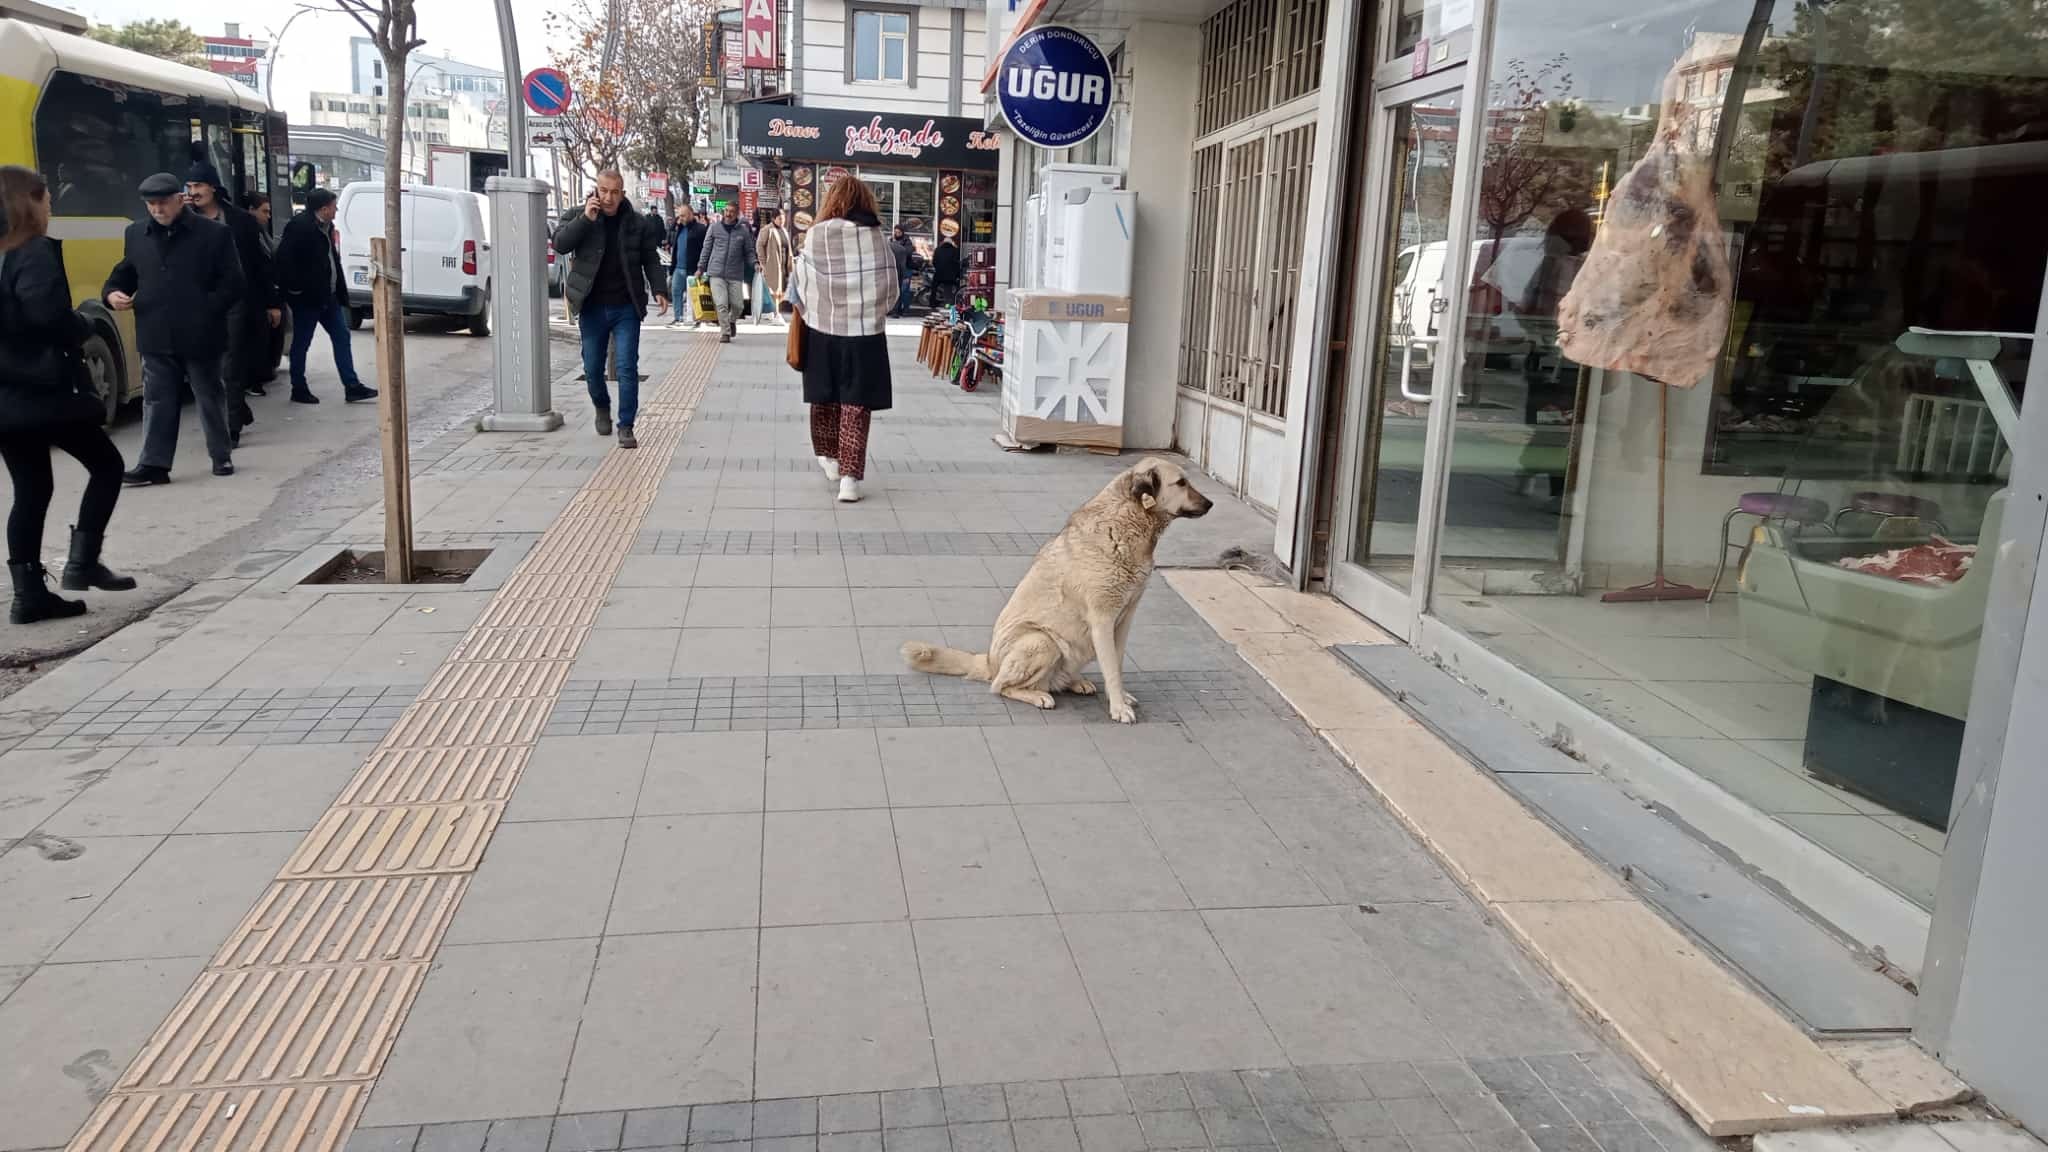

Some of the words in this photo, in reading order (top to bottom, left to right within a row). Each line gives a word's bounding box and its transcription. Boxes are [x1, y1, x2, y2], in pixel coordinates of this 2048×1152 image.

[1019, 32, 1045, 54] DERİN
[1047, 30, 1100, 60] DONDURUCU
[1007, 65, 1105, 105] UĞUR
[767, 118, 820, 139] Döner
[747, 173, 758, 185] E
[442, 256, 457, 269] FIAT
